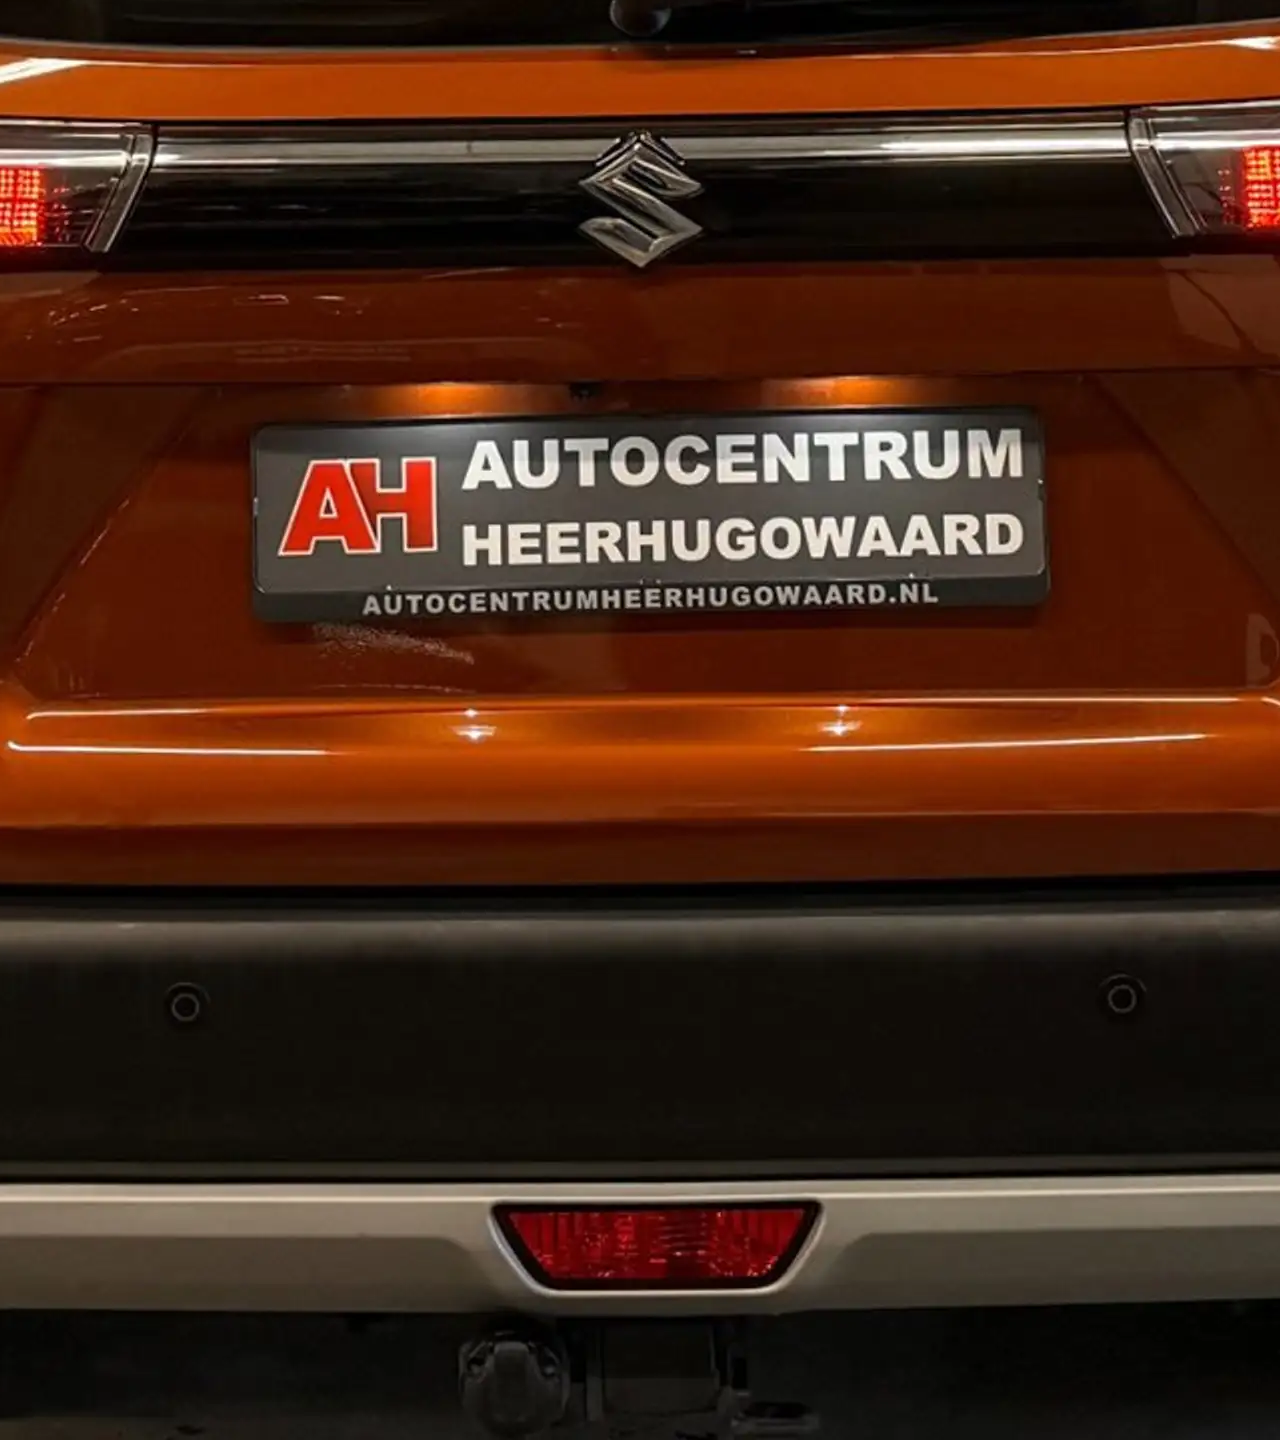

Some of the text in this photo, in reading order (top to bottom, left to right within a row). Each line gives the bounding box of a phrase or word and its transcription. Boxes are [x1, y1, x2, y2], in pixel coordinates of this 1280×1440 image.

[462, 428, 1024, 491] AUTOCENTRUM
[278, 458, 439, 558] AH
[463, 513, 1024, 567] HEERHUGOWAARD
[362, 583, 938, 616] AUTOCENTRUMHEERHUGOWAARD.NL
